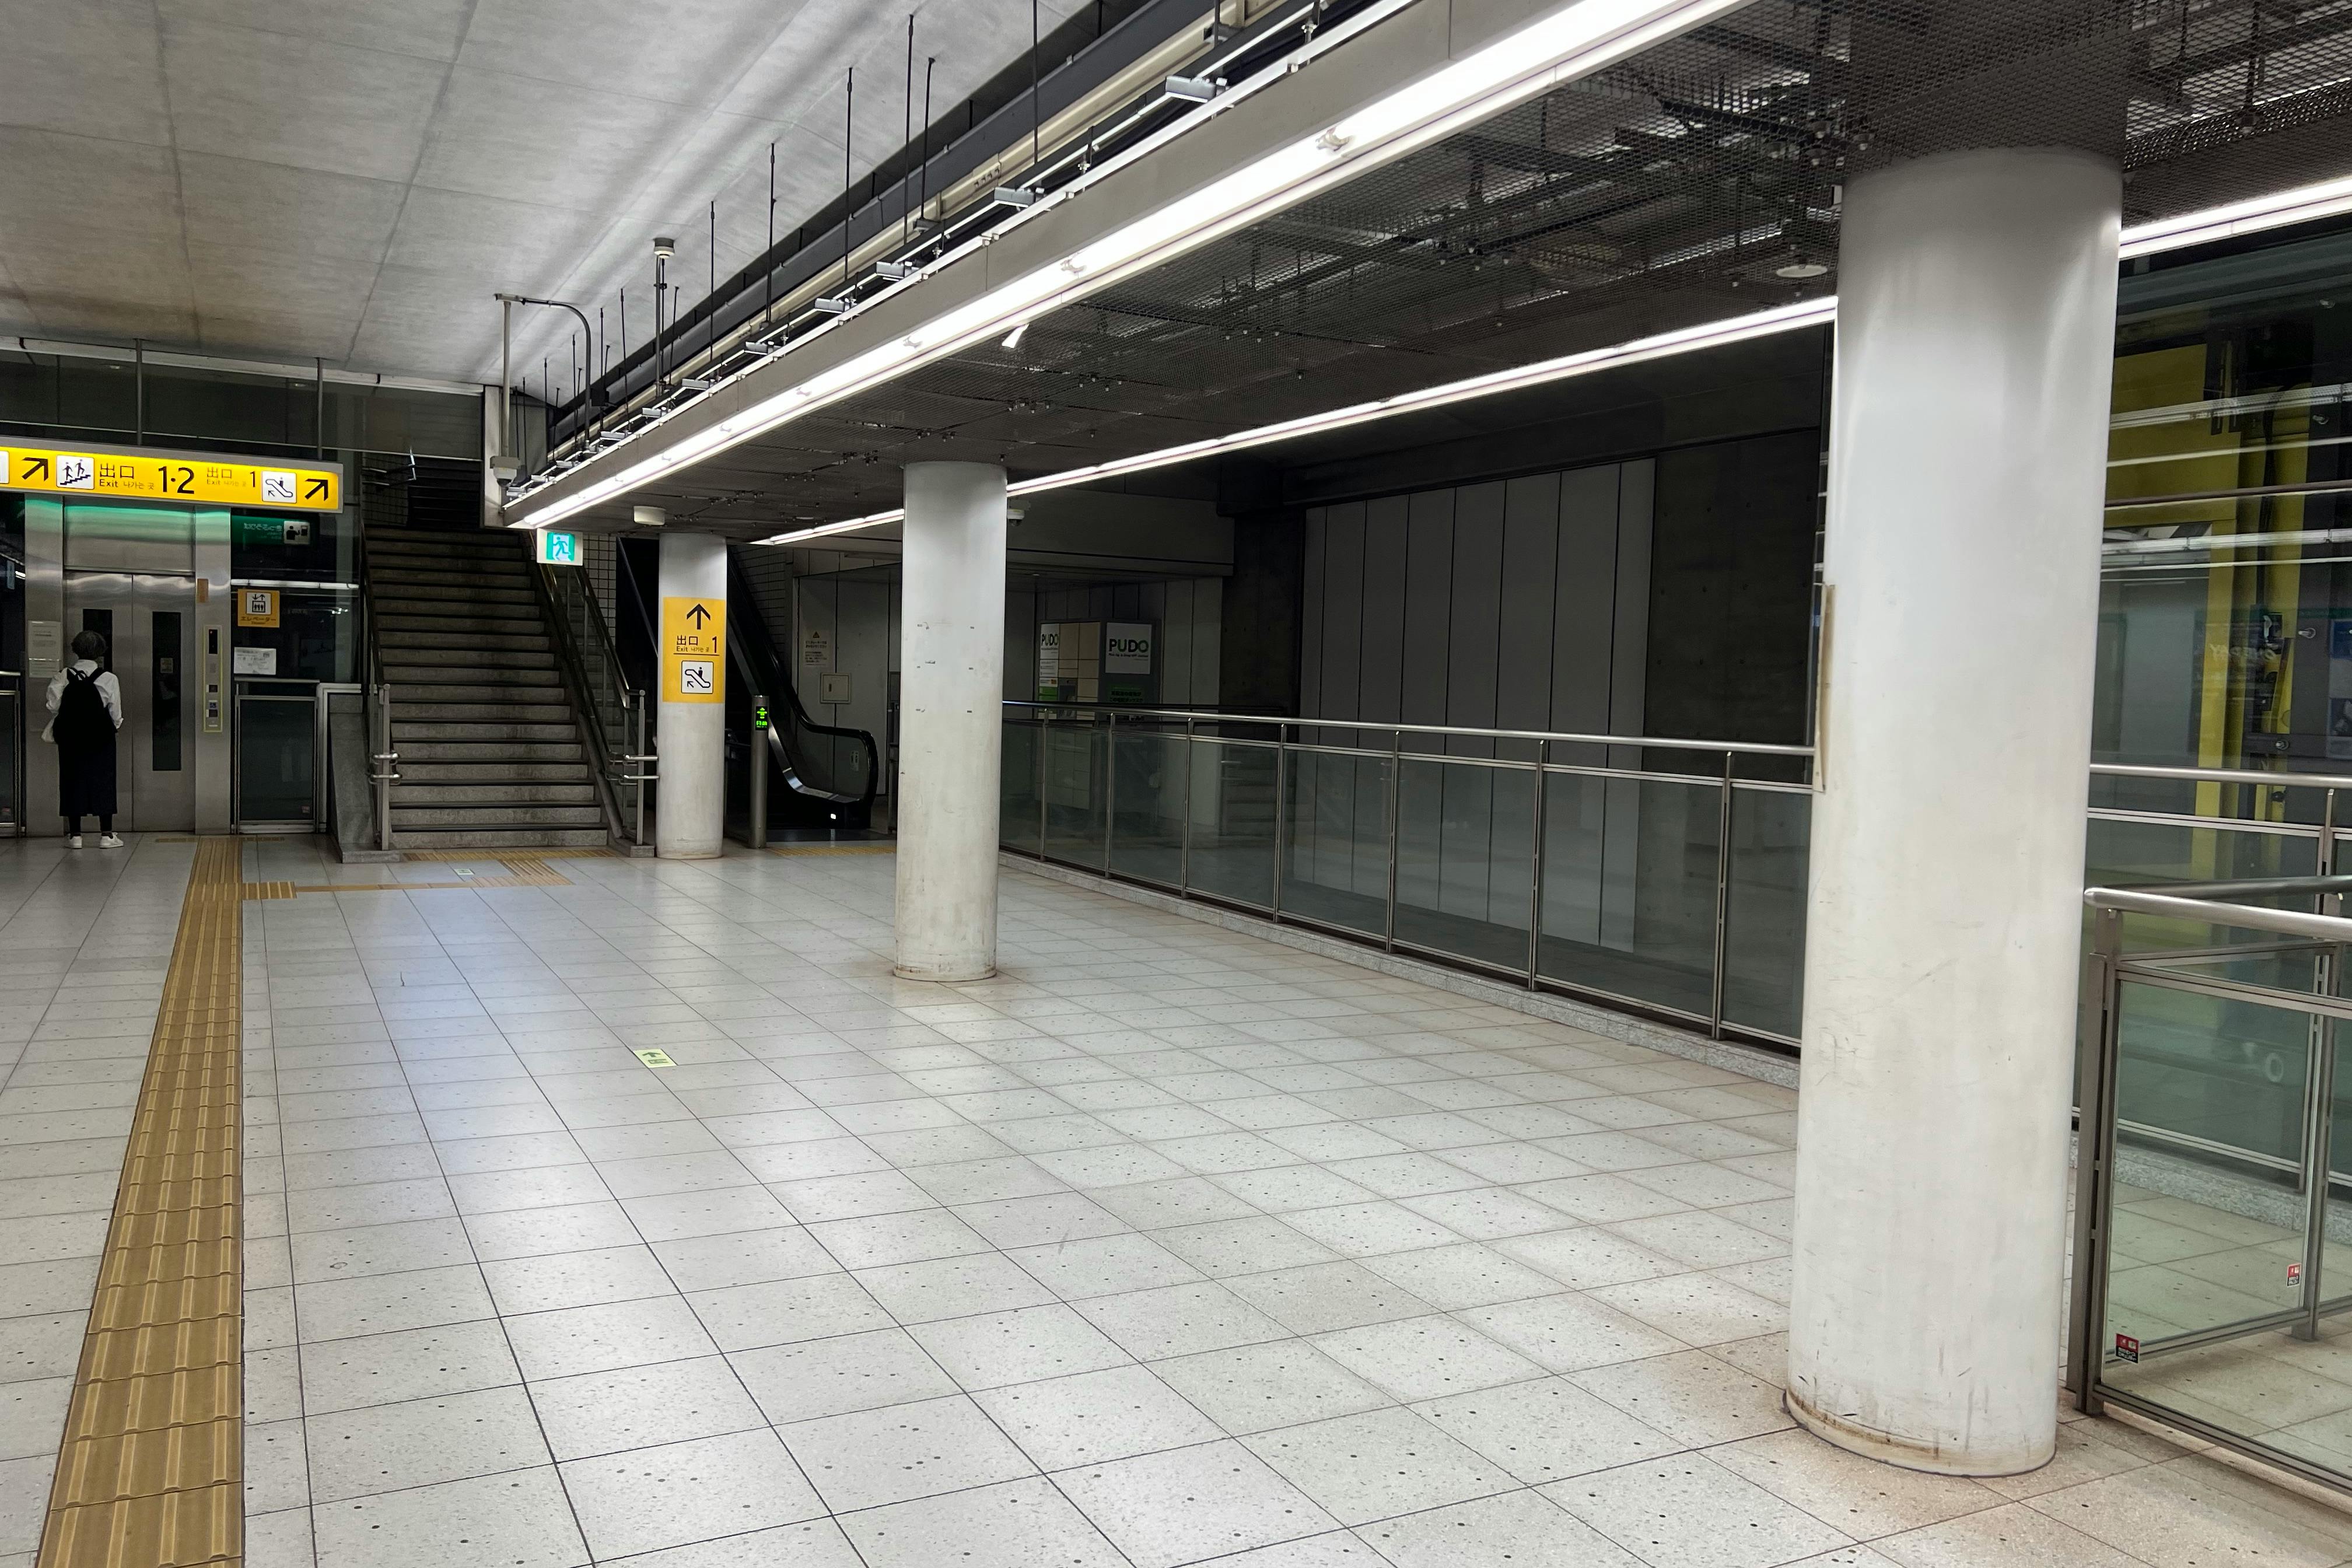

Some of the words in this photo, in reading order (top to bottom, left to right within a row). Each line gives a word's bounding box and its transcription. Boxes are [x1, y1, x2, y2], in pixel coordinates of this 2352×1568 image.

[100, 463, 134, 479] 出口
[206, 467, 232, 479] 出口
[99, 479, 118, 488] Exit
[250, 471, 256, 488] 1
[677, 635, 698, 646] 出口
[712, 636, 717, 653] 1
[1041, 634, 1059, 646] PUDO
[1109, 639, 1149, 653] PUDO
